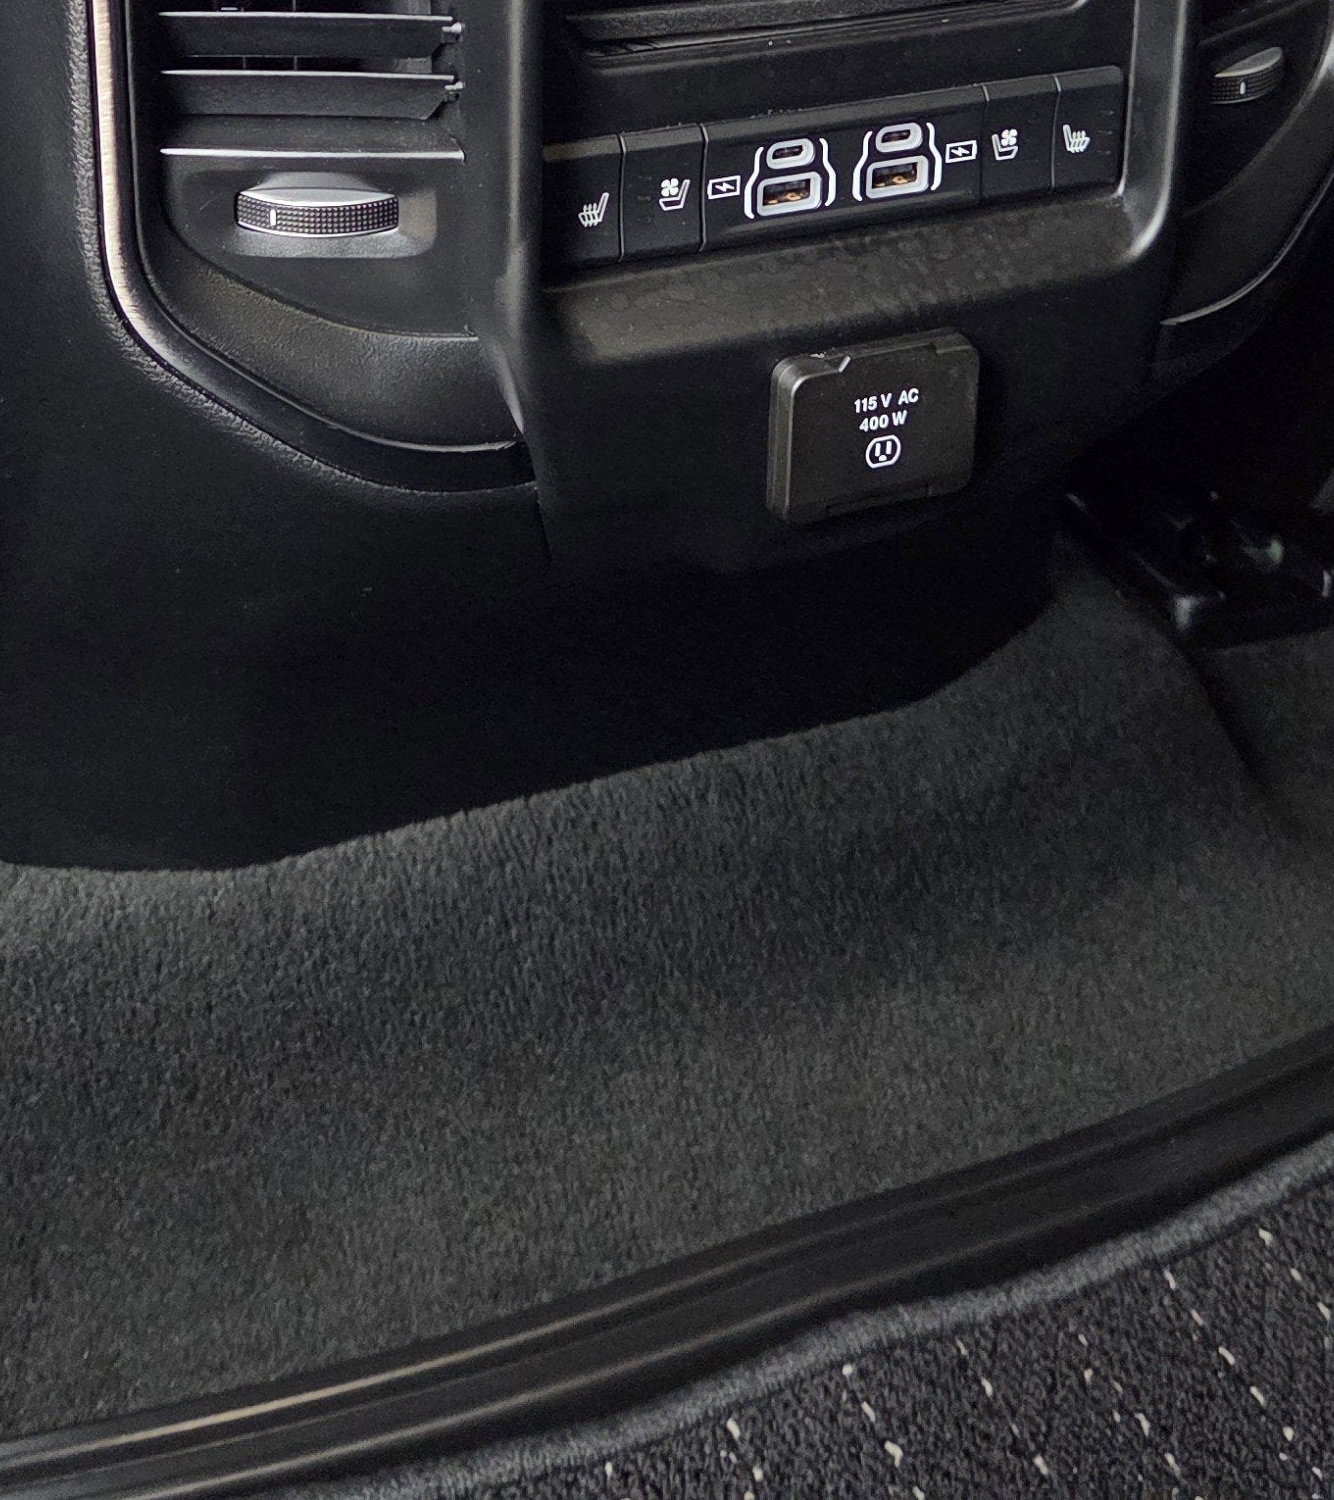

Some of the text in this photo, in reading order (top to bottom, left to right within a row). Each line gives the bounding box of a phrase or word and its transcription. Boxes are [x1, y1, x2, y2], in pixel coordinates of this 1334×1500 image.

[854, 387, 919, 414] 115 V AC
[858, 409, 908, 432] 400 W
